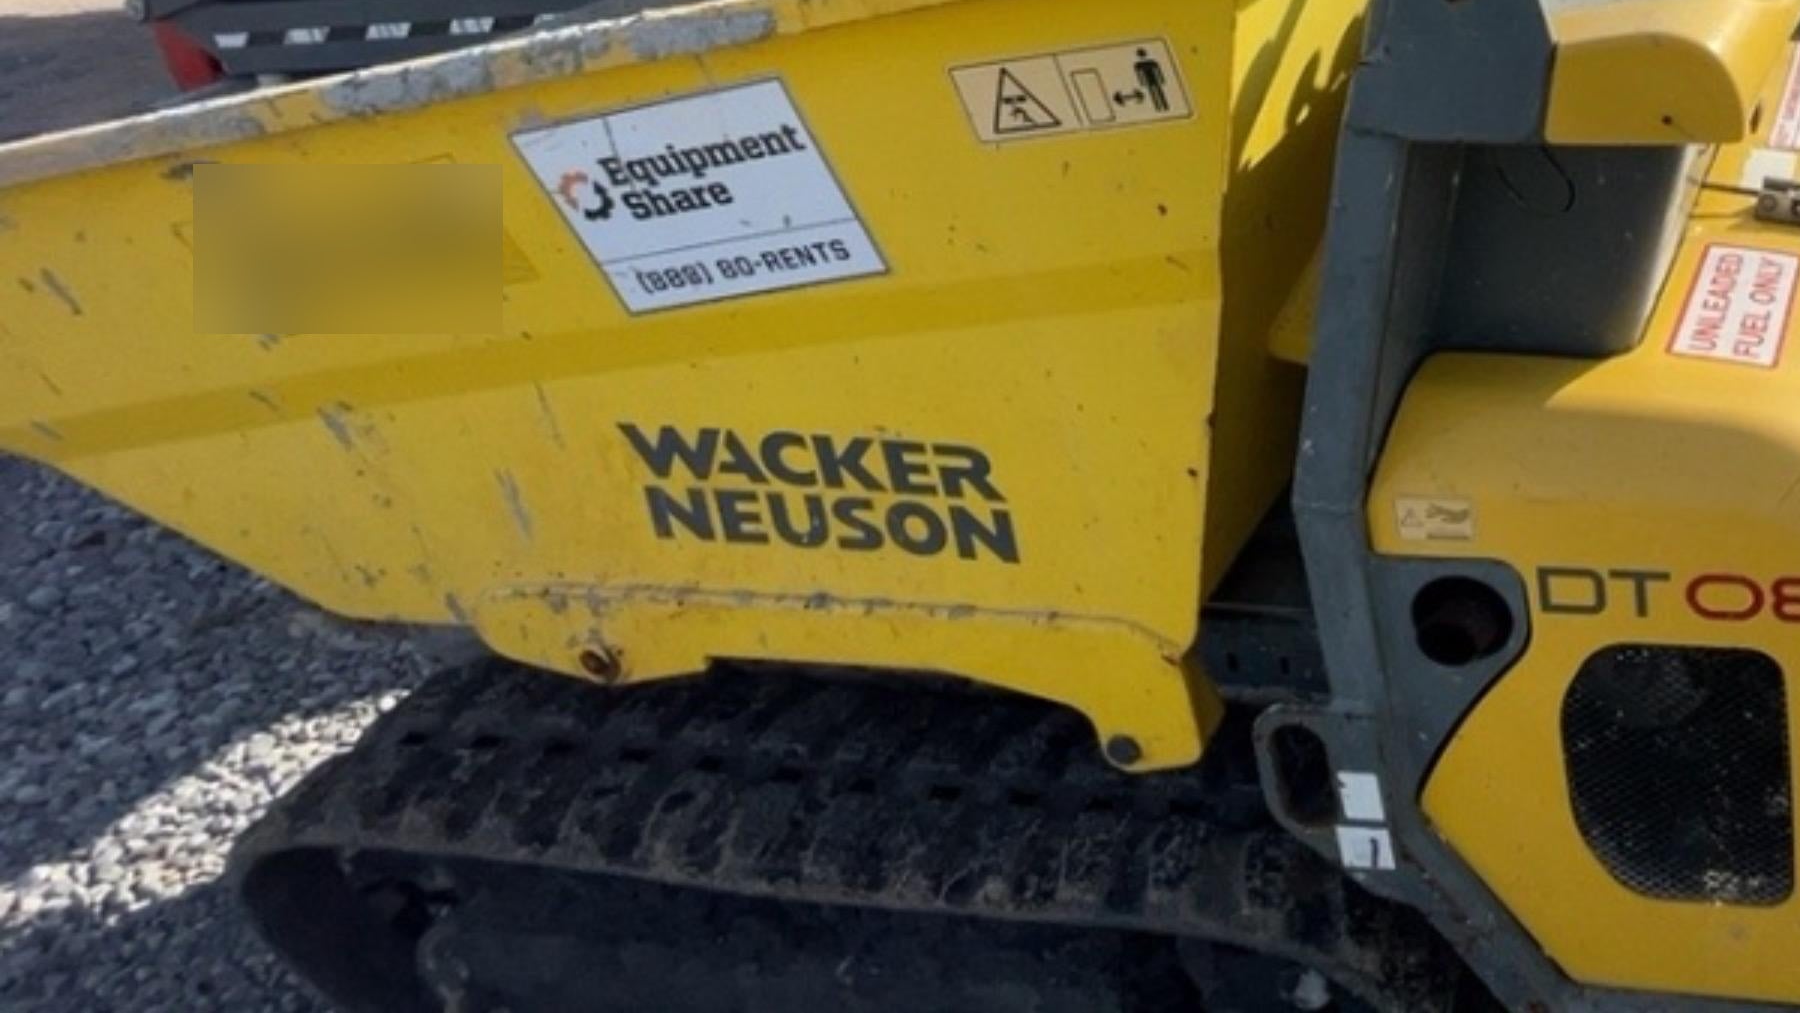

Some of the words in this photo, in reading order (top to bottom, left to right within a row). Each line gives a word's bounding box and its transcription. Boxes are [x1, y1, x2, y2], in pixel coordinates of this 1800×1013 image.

[598, 124, 806, 187] Equipment
[621, 181, 735, 221] Share
[635, 261, 714, 295] (888)
[716, 238, 851, 279] 80-RENTS
[1750, 257, 1783, 305] ONLY
[1688, 252, 1743, 350] UNLEADED
[1733, 309, 1771, 359] FUEL
[616, 422, 1008, 502] WACKER
[644, 484, 1021, 564] NEUSON
[1536, 565, 1672, 618] DT
